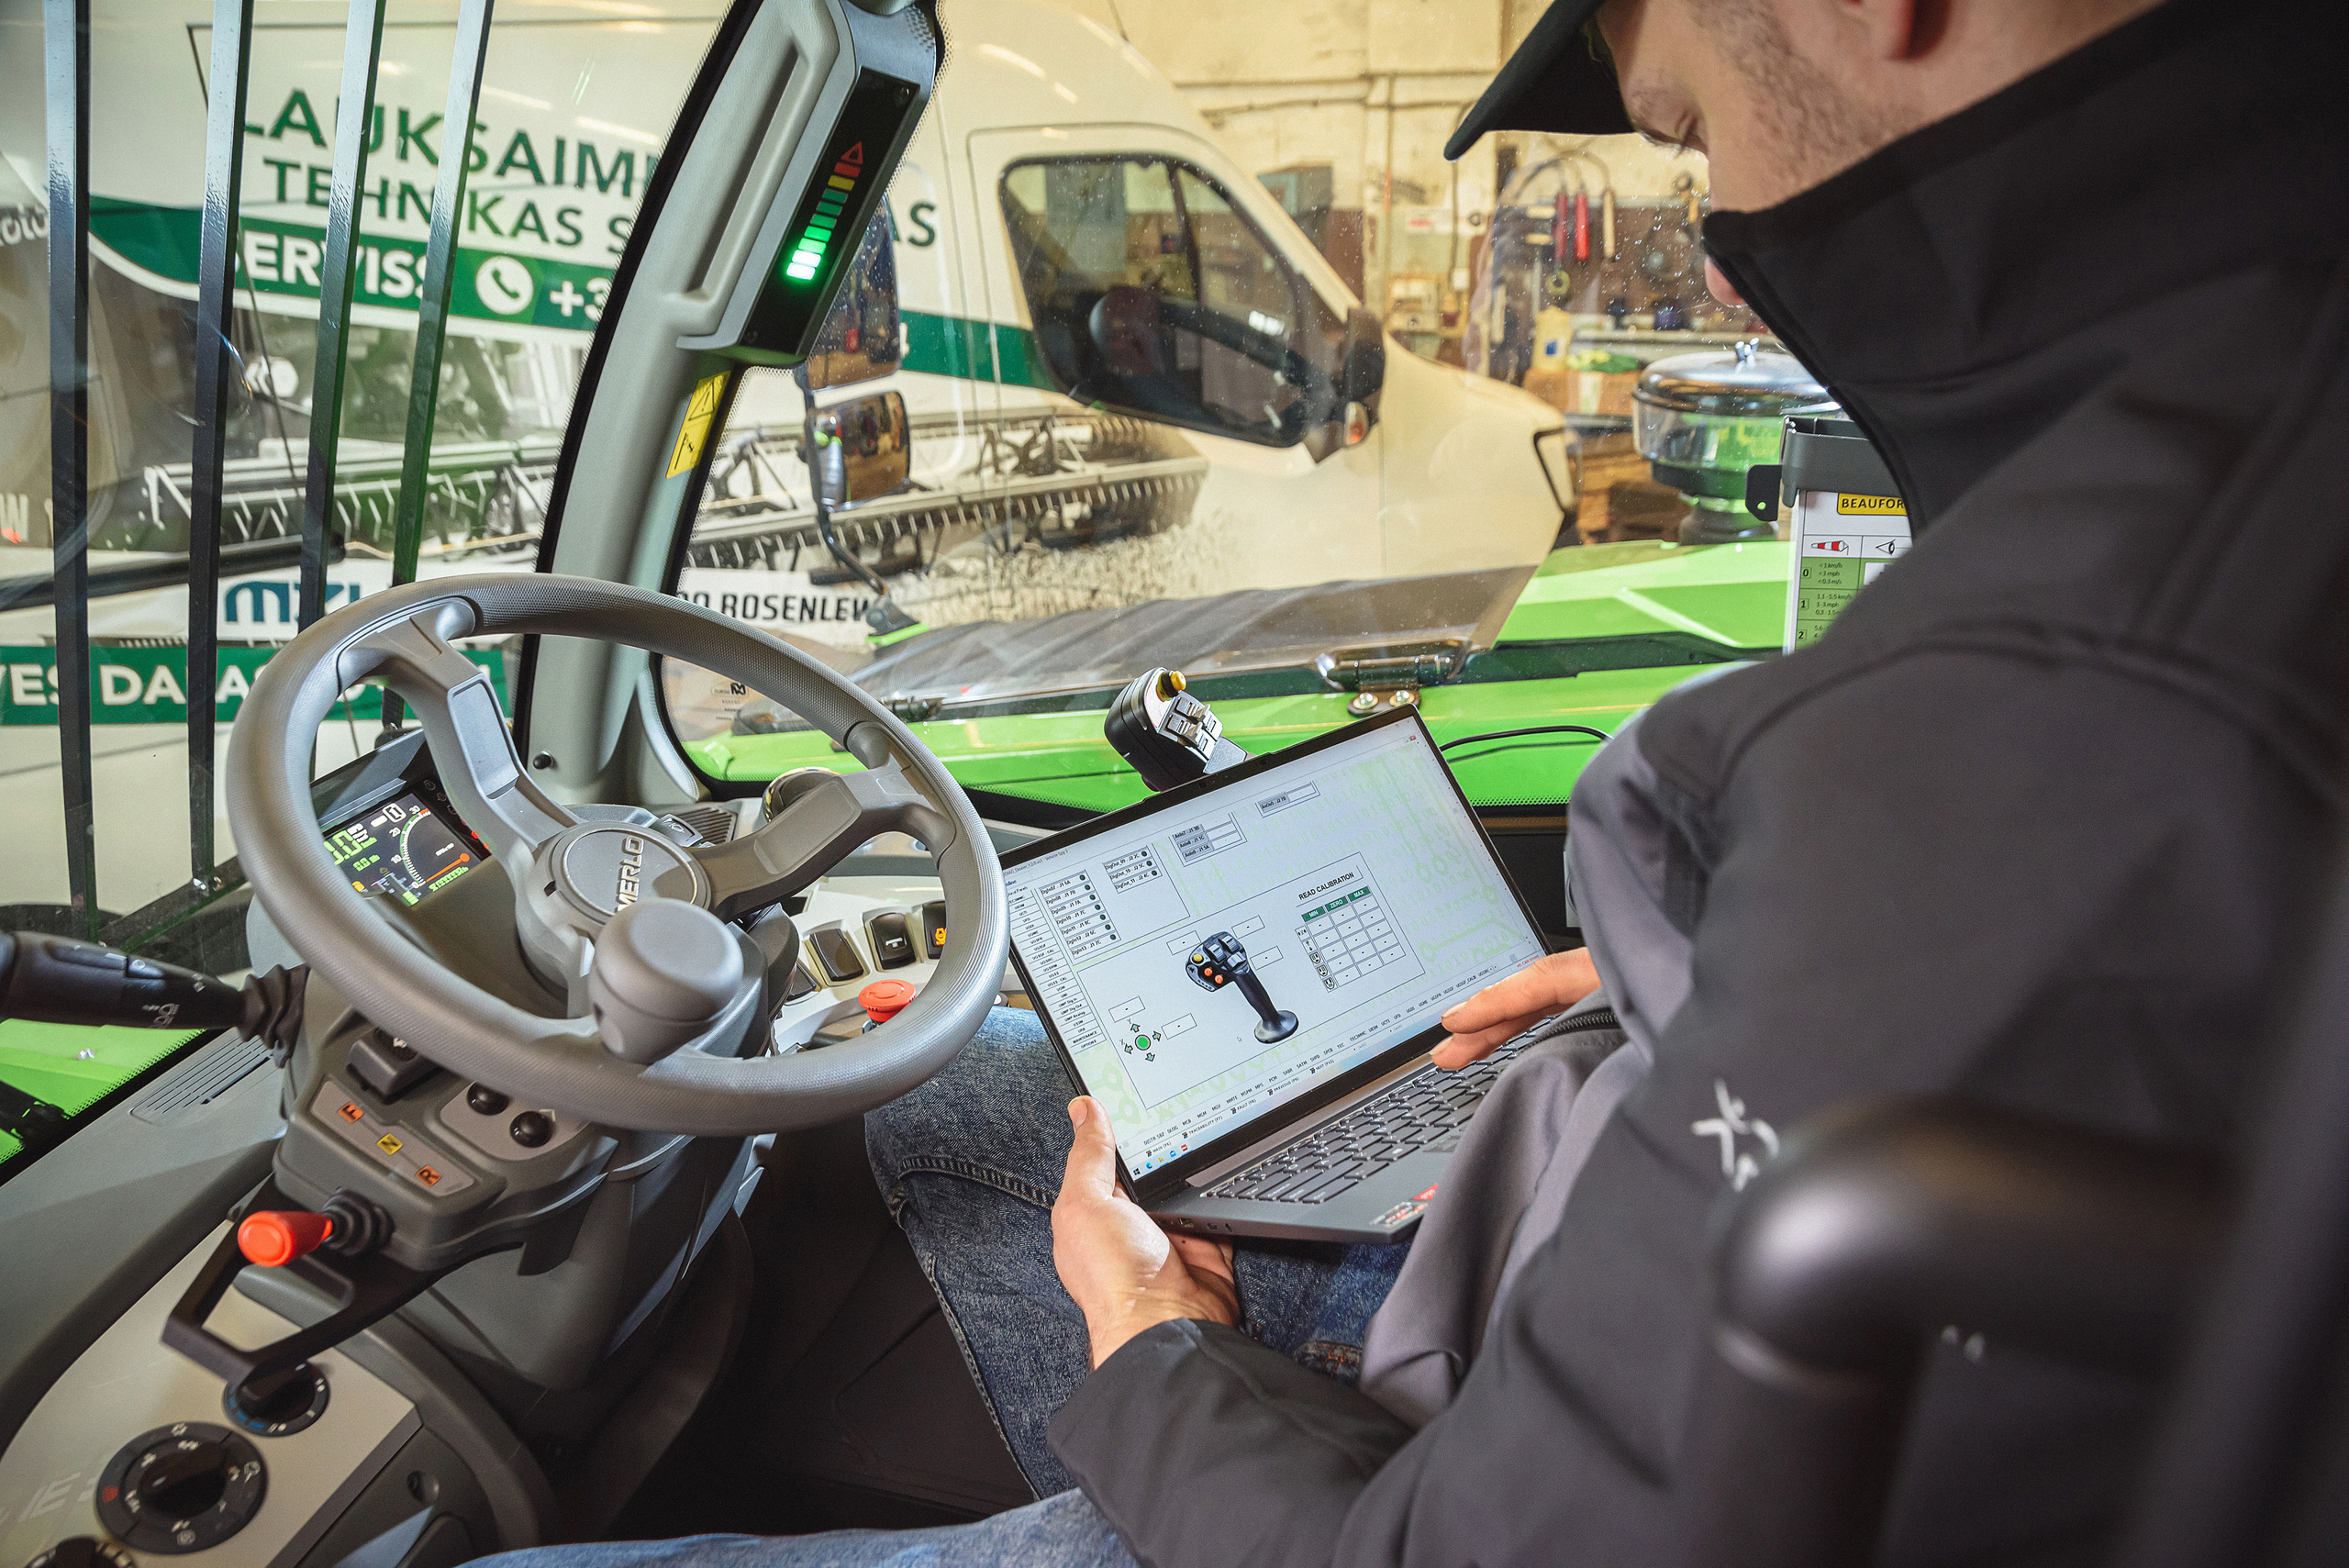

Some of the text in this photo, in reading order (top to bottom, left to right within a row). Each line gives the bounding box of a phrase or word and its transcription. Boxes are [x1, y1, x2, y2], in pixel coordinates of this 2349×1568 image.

[1803, 569, 1809, 577] 0
[1800, 600, 1807, 608] 1
[1798, 631, 1804, 639] 2
[1297, 872, 1354, 900] READ CALIBRATION
[1308, 889, 1364, 917] MIN ZERO MAX
[418, 1169, 440, 1184] R
